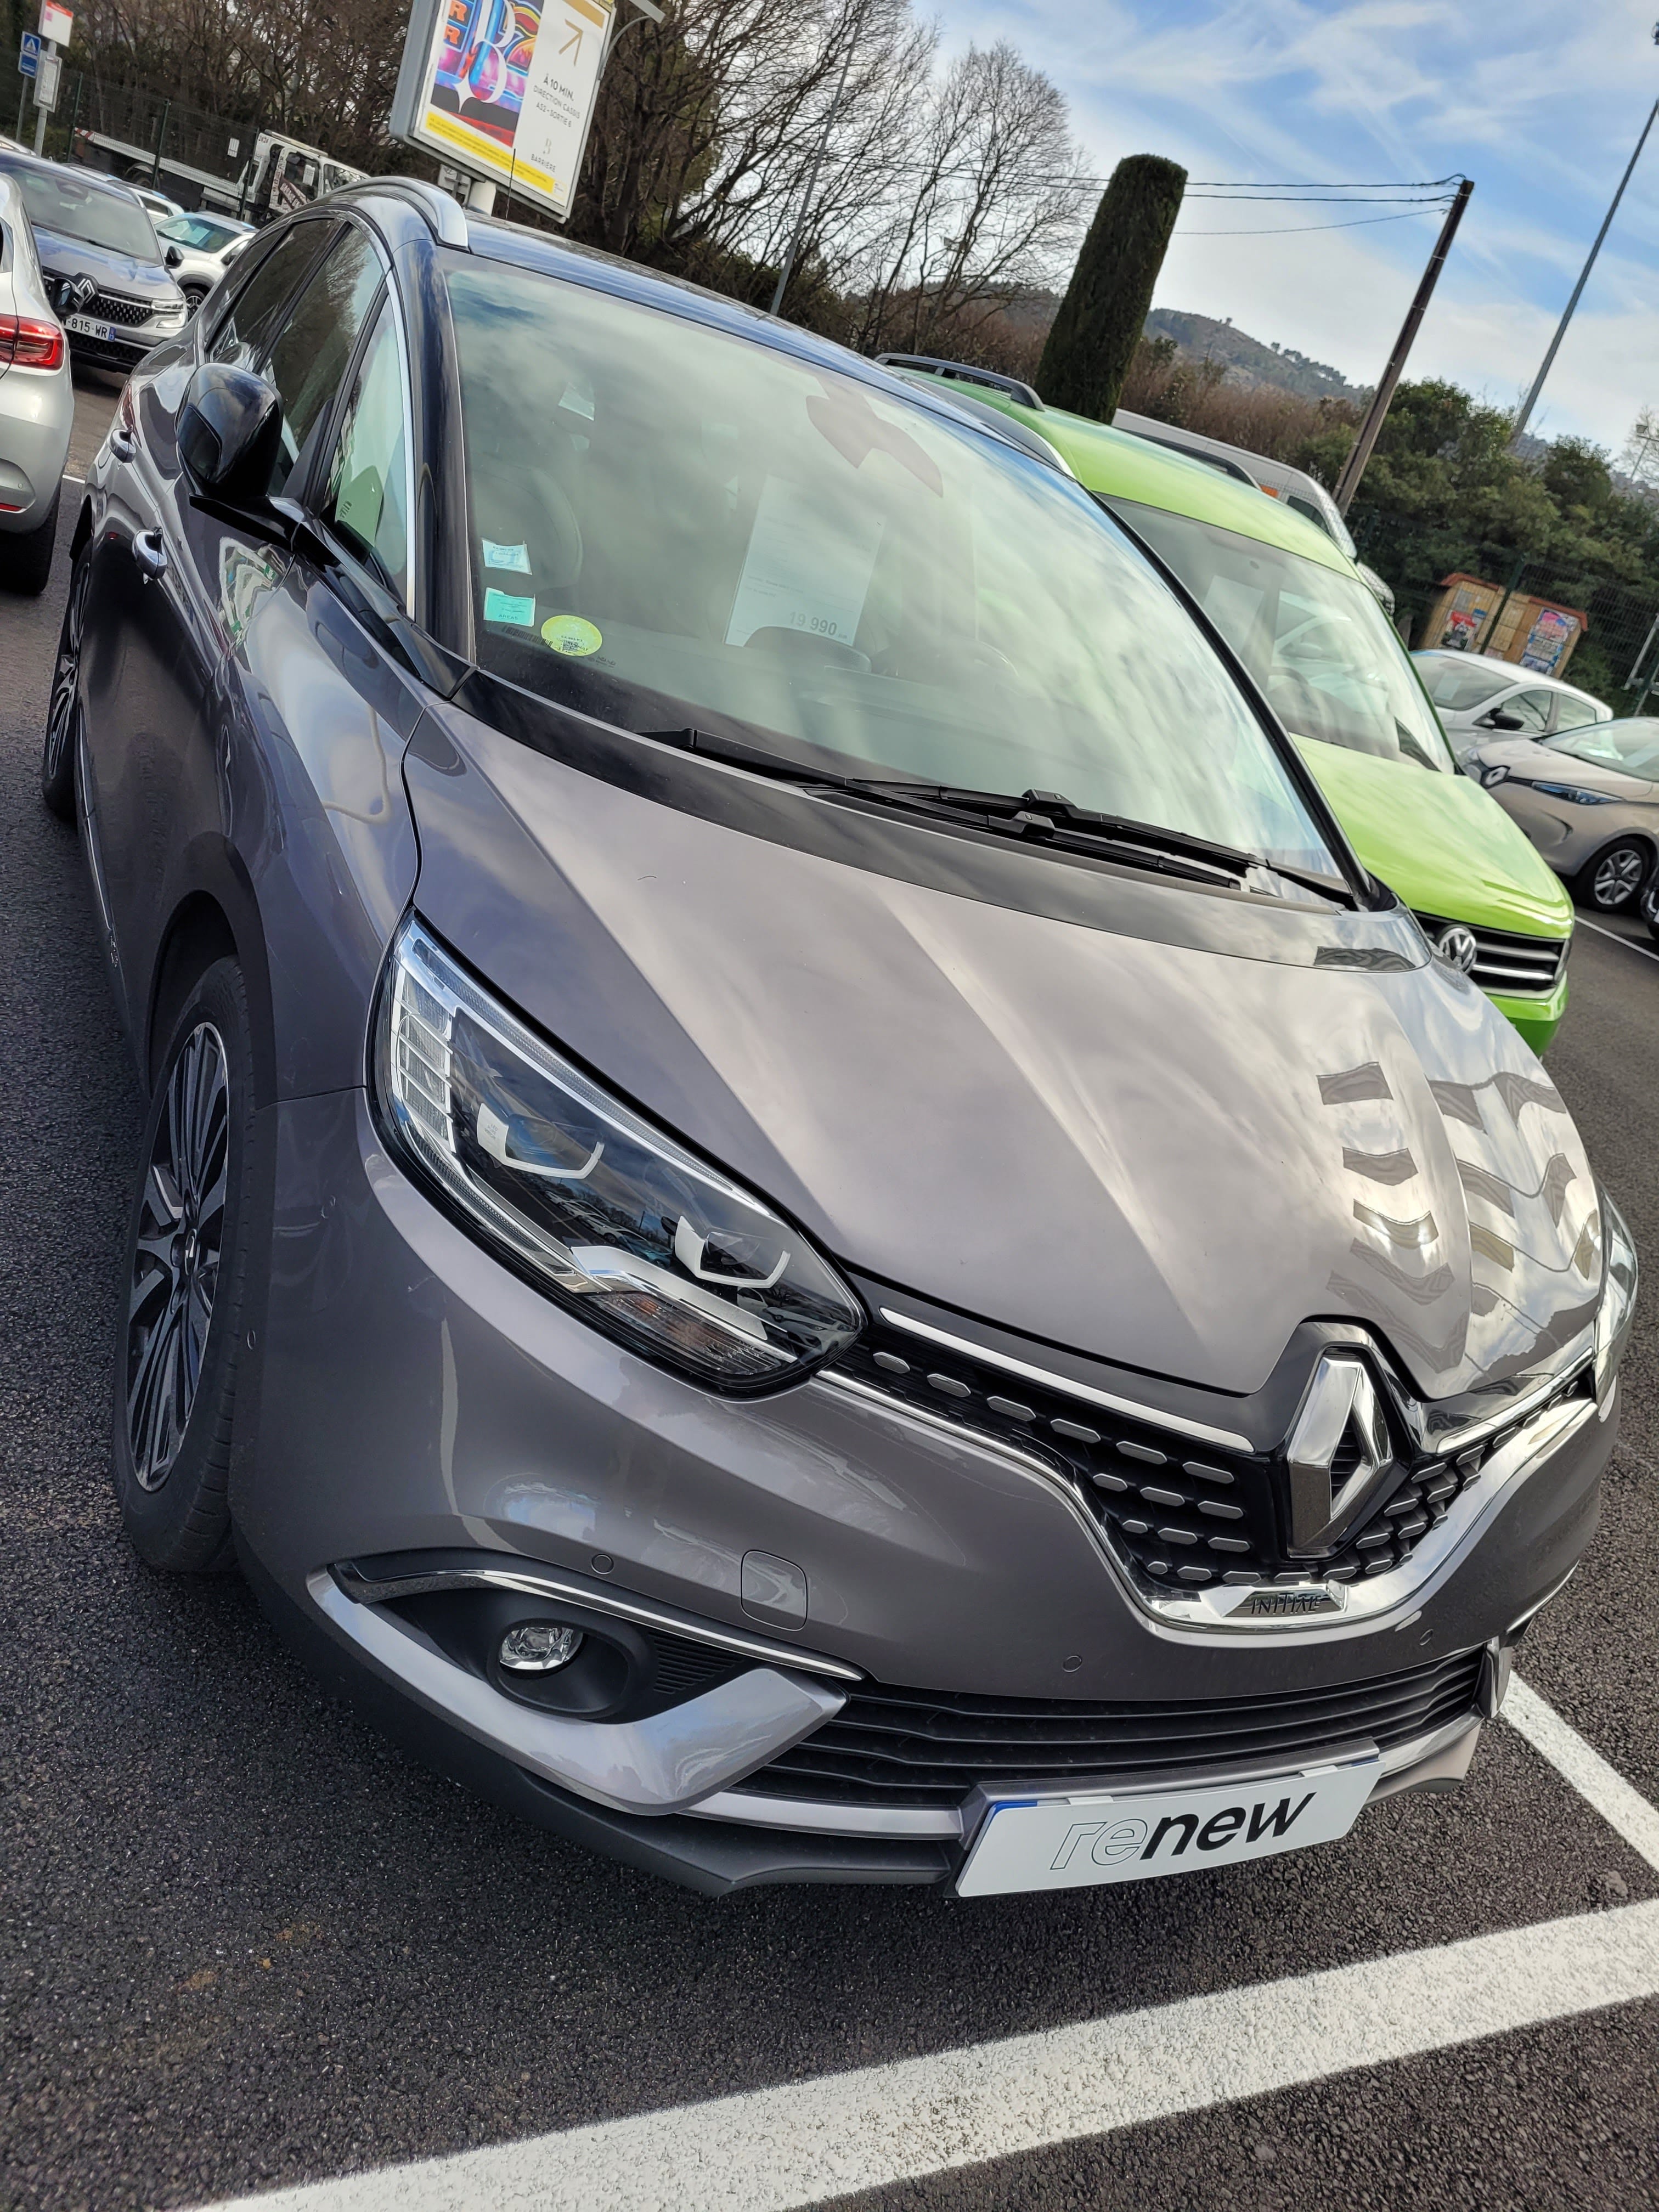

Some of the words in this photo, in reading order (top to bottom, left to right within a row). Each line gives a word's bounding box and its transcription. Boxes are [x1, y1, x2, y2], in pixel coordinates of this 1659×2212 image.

[533, 85, 561, 107] DIRECTION
[550, 78, 558, 91] 10
[790, 611, 806, 627] 19
[810, 617, 837, 636] 990
[1049, 1791, 1317, 1871] renew
